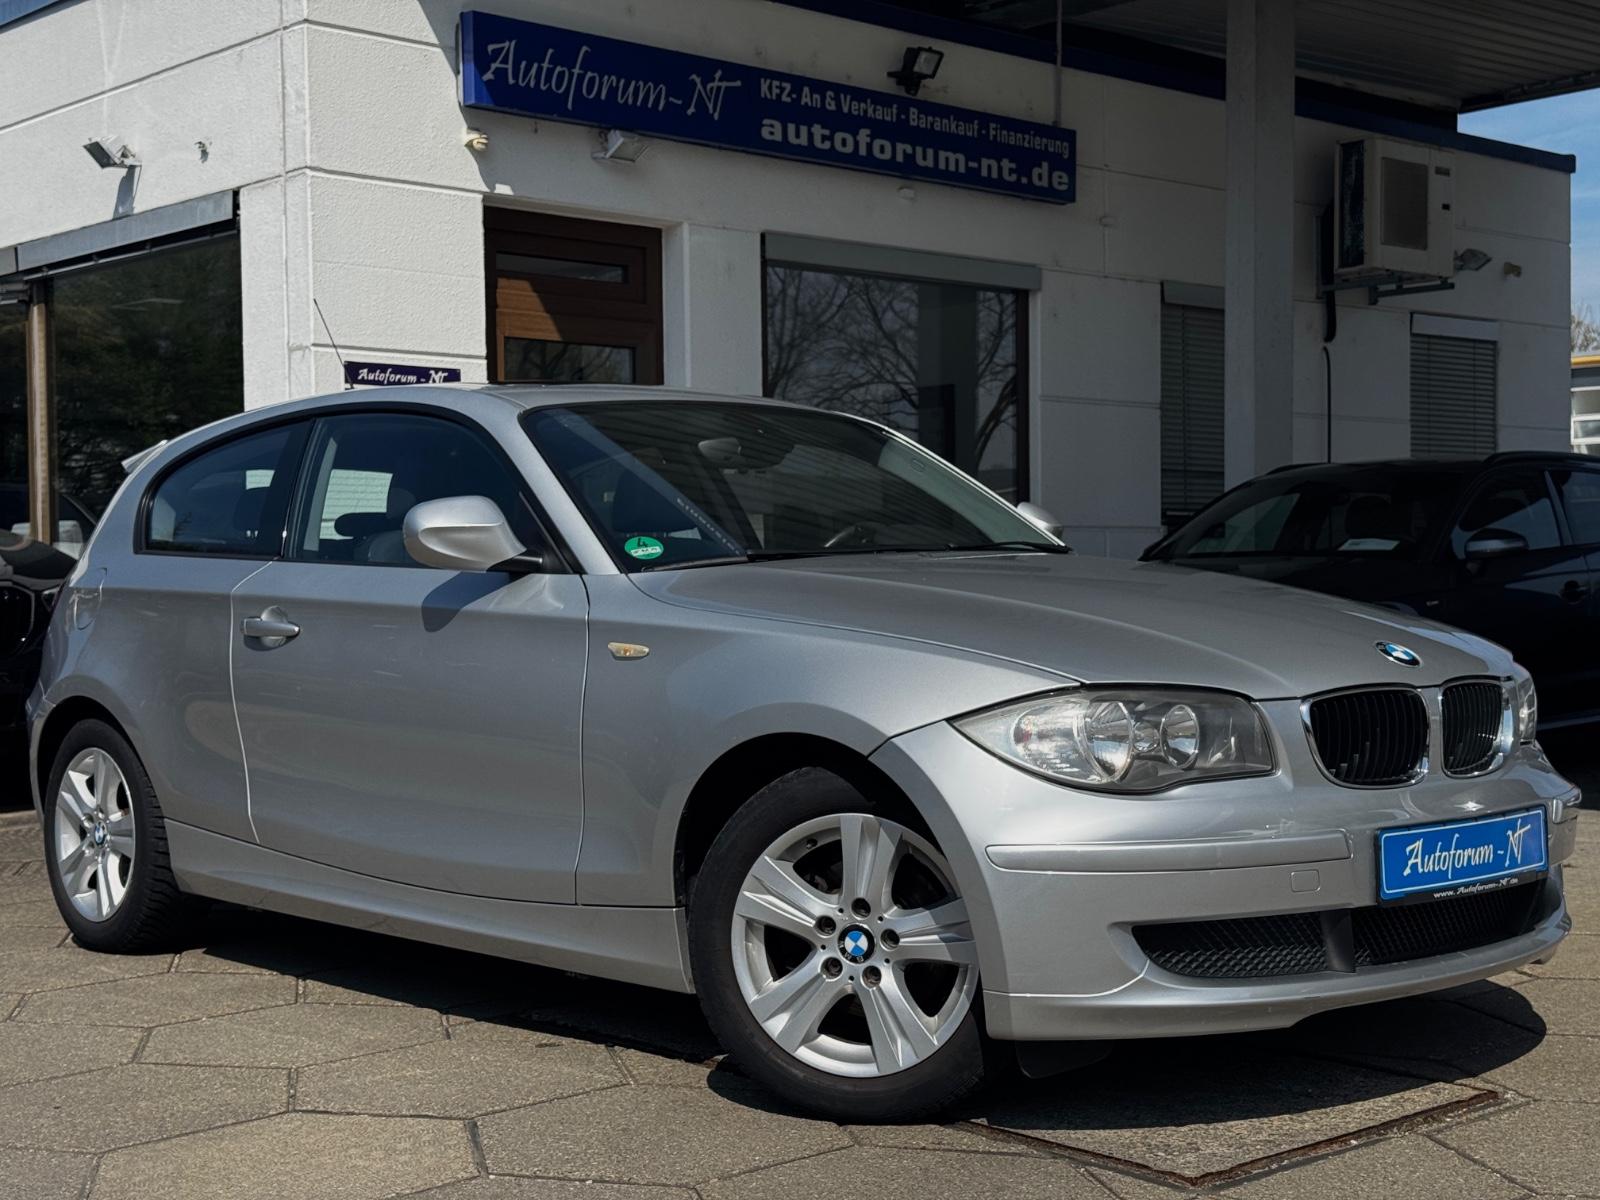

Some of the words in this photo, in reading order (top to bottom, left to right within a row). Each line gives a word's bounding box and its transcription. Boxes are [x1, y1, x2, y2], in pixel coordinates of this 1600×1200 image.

[760, 78, 797, 102] KFZ-
[800, 86, 821, 108] An
[825, 91, 836, 110] &
[841, 93, 899, 122] Verkauf
[909, 107, 979, 137] Barankauf
[989, 122, 1069, 159] Finanzierung
[761, 118, 1069, 191] autoforum-nt.de
